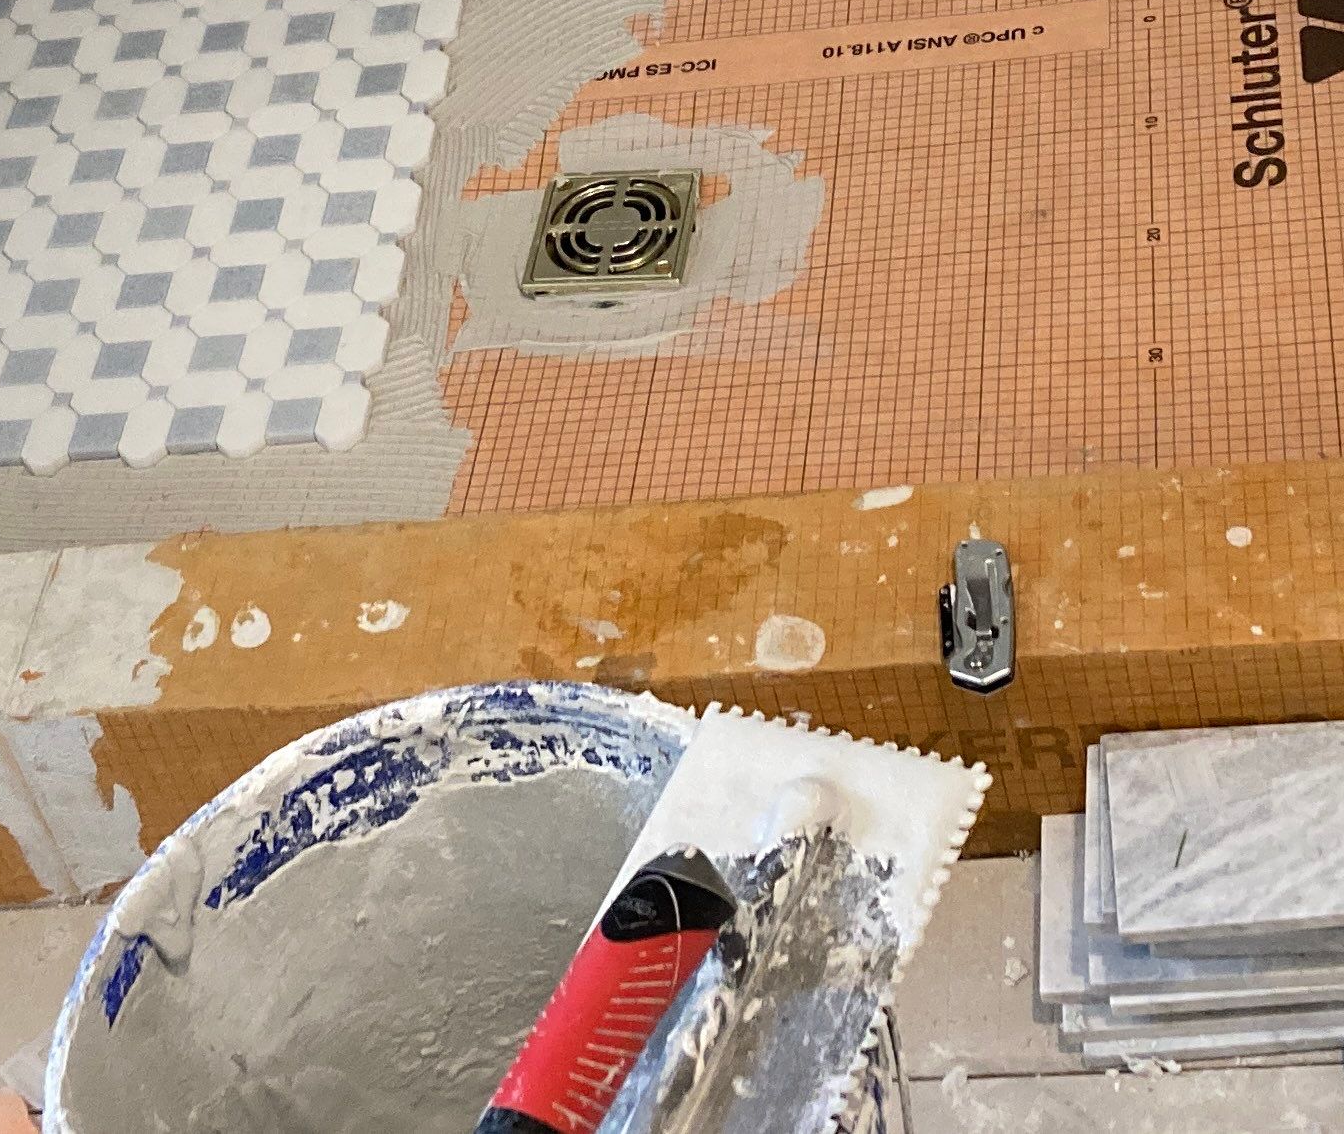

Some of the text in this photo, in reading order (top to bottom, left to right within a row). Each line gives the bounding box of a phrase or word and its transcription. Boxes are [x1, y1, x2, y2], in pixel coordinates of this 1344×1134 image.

[821, 39, 903, 60] A118.10
[906, 34, 958, 51] ANSI
[645, 58, 718, 77] ICC-ES
[1145, 115, 1159, 130] 10
[1146, 227, 1161, 242] 20
[1148, 347, 1163, 363] 30
